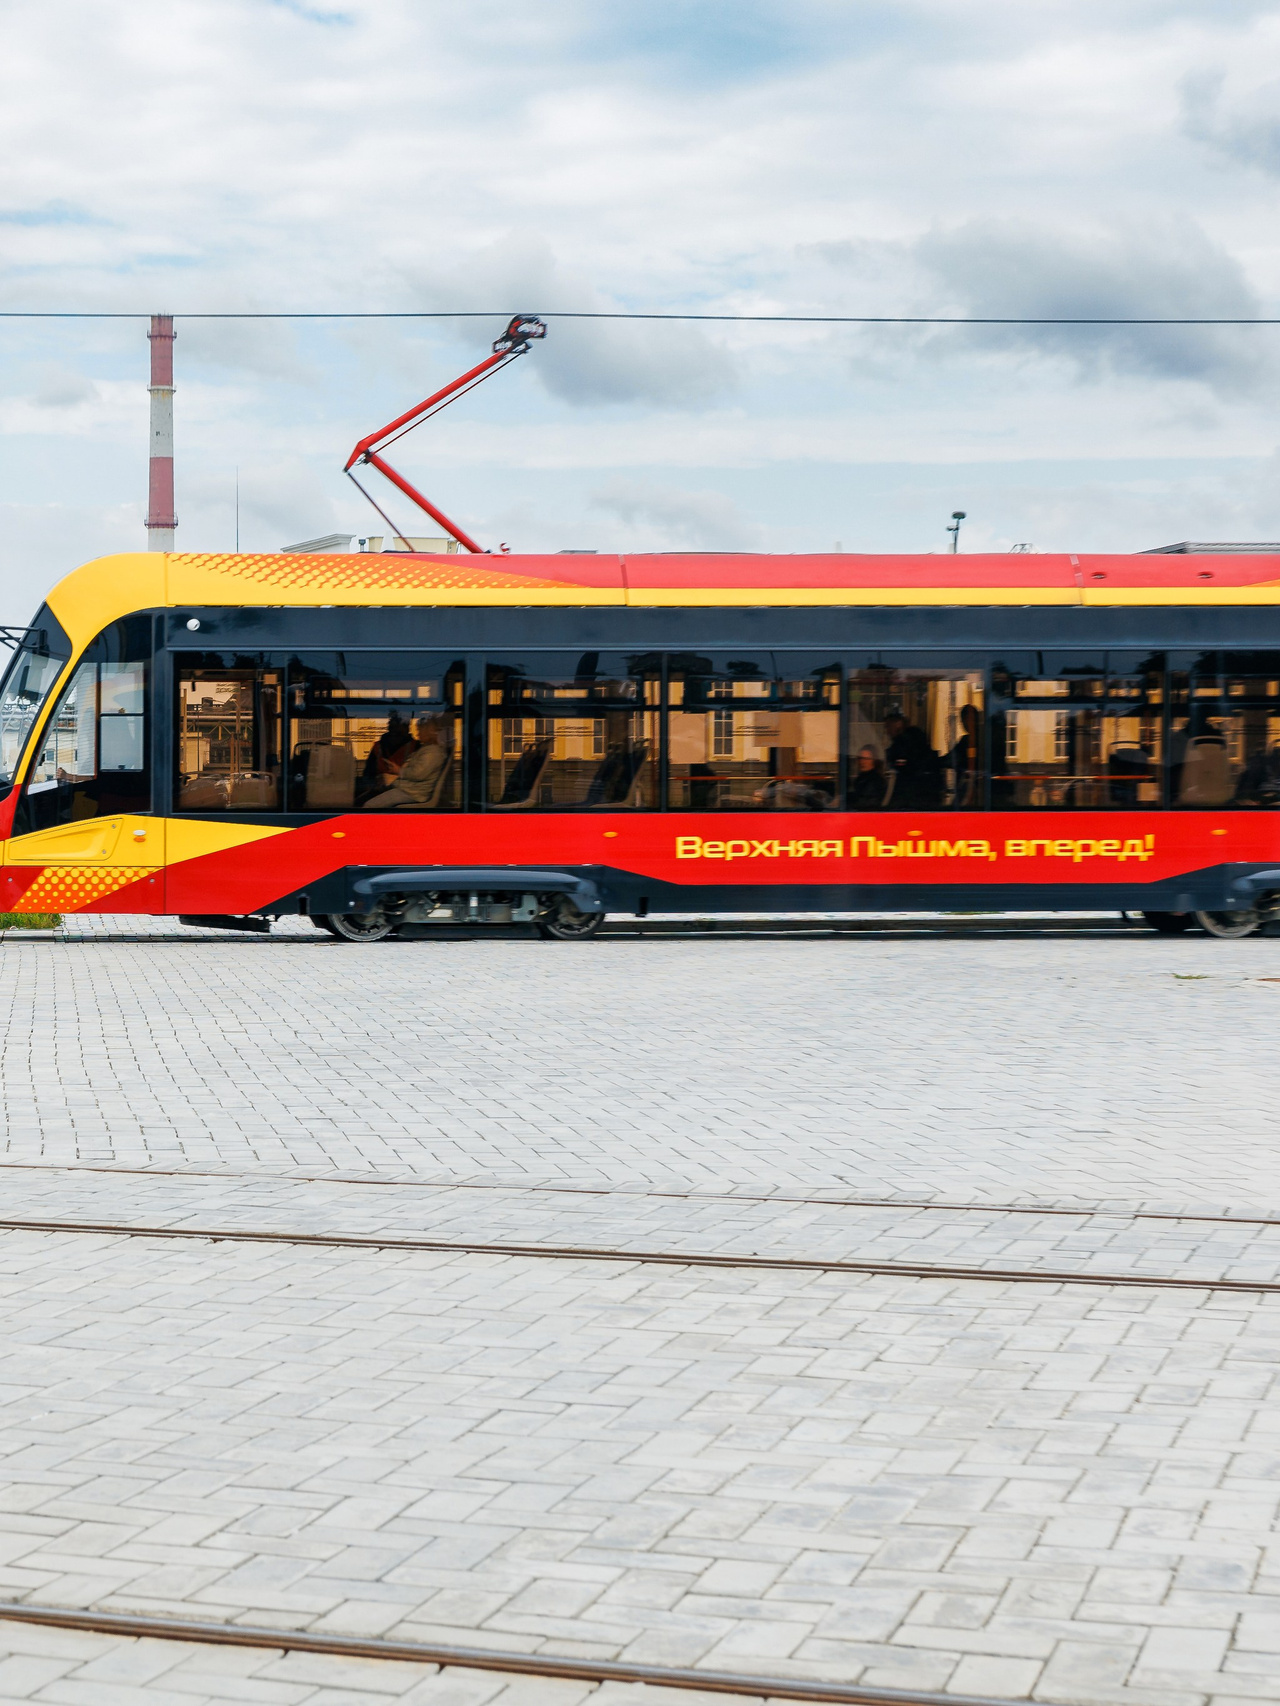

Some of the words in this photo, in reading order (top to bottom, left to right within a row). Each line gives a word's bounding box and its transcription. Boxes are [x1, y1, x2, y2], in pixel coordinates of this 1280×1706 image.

[675, 836, 844, 861] Верхняя
[850, 836, 998, 862] Пышма,
[1004, 833, 1155, 863] вперед!
